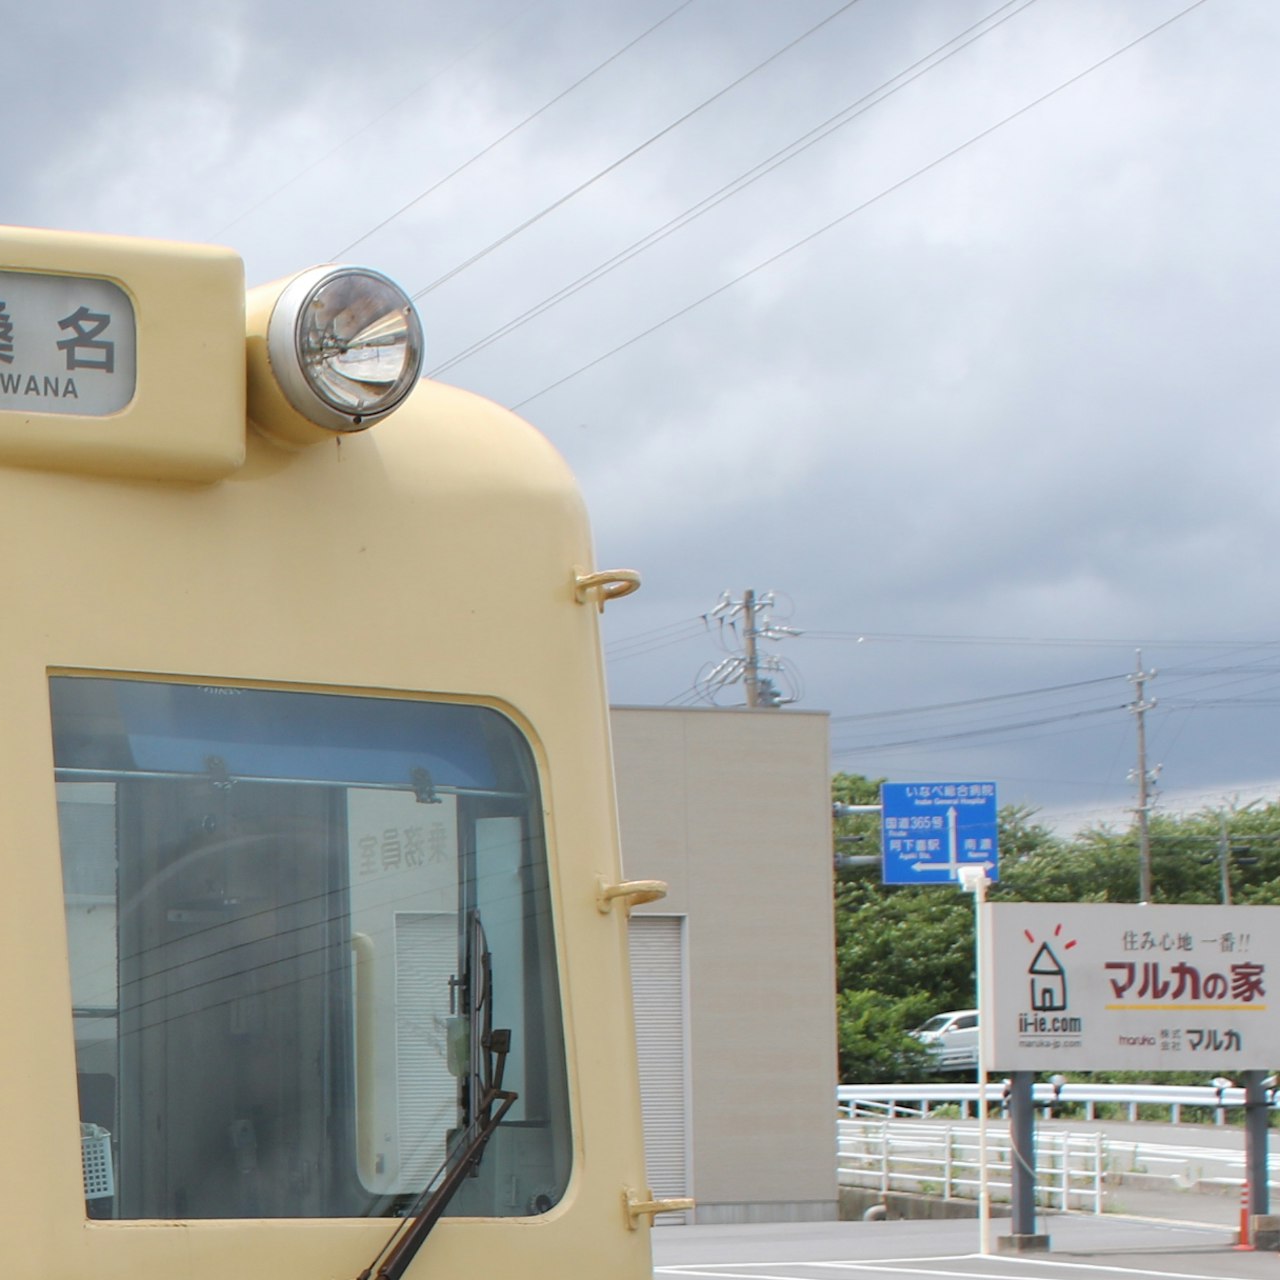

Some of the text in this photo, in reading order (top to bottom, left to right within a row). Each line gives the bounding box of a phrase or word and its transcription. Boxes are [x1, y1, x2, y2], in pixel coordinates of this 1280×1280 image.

[905, 784, 994, 797] いなべ総合病院
[885, 816, 944, 829] 国道365号
[1122, 930, 1194, 951] 住み心地
[1105, 962, 1266, 1002] マルカの家
[1019, 1013, 1082, 1032] ii-ie.com
[1019, 1040, 1082, 1049] maruka-jp.com
[1186, 1029, 1242, 1051] マルカ
